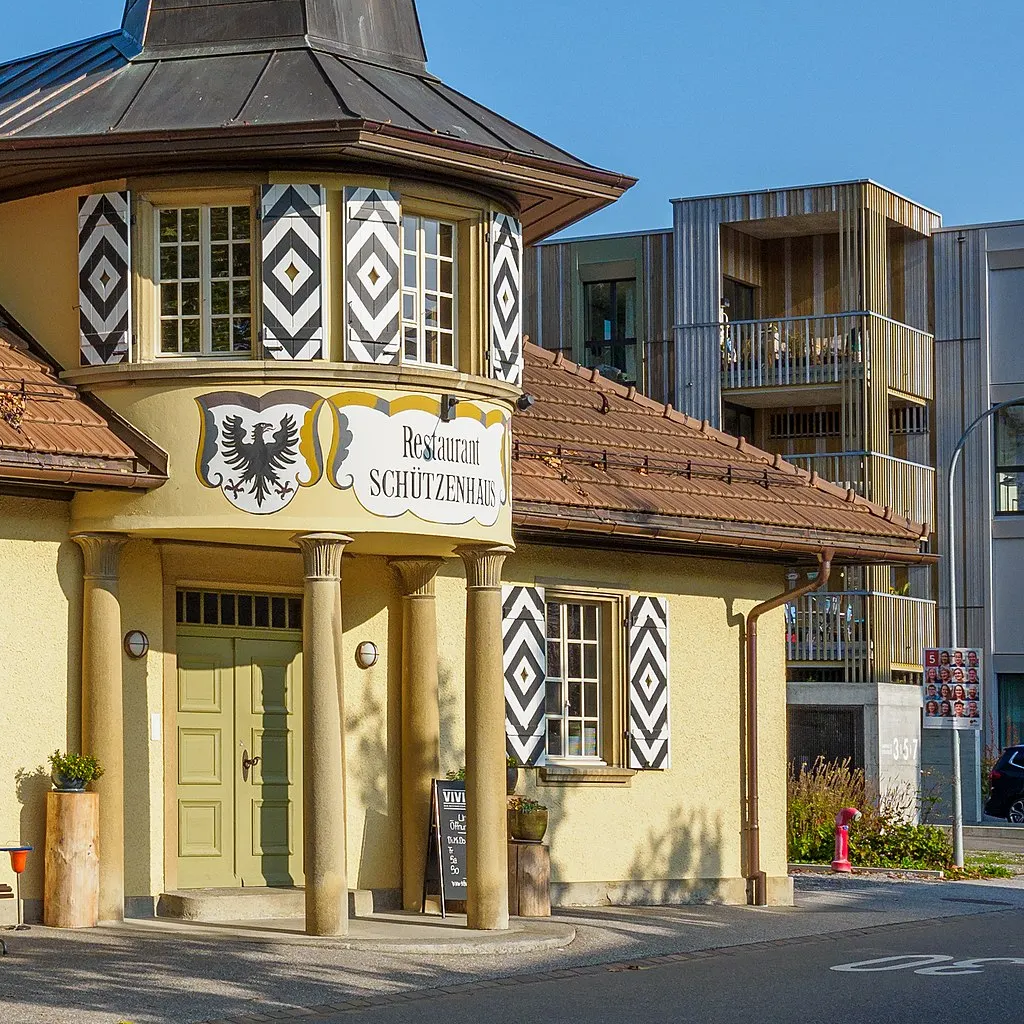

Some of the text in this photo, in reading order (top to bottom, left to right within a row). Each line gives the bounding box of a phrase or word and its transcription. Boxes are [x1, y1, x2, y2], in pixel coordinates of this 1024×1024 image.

[402, 425, 480, 465] Restaurant
[369, 467, 496, 507] SCHÜTZENHAUS
[929, 654, 935, 664] 5
